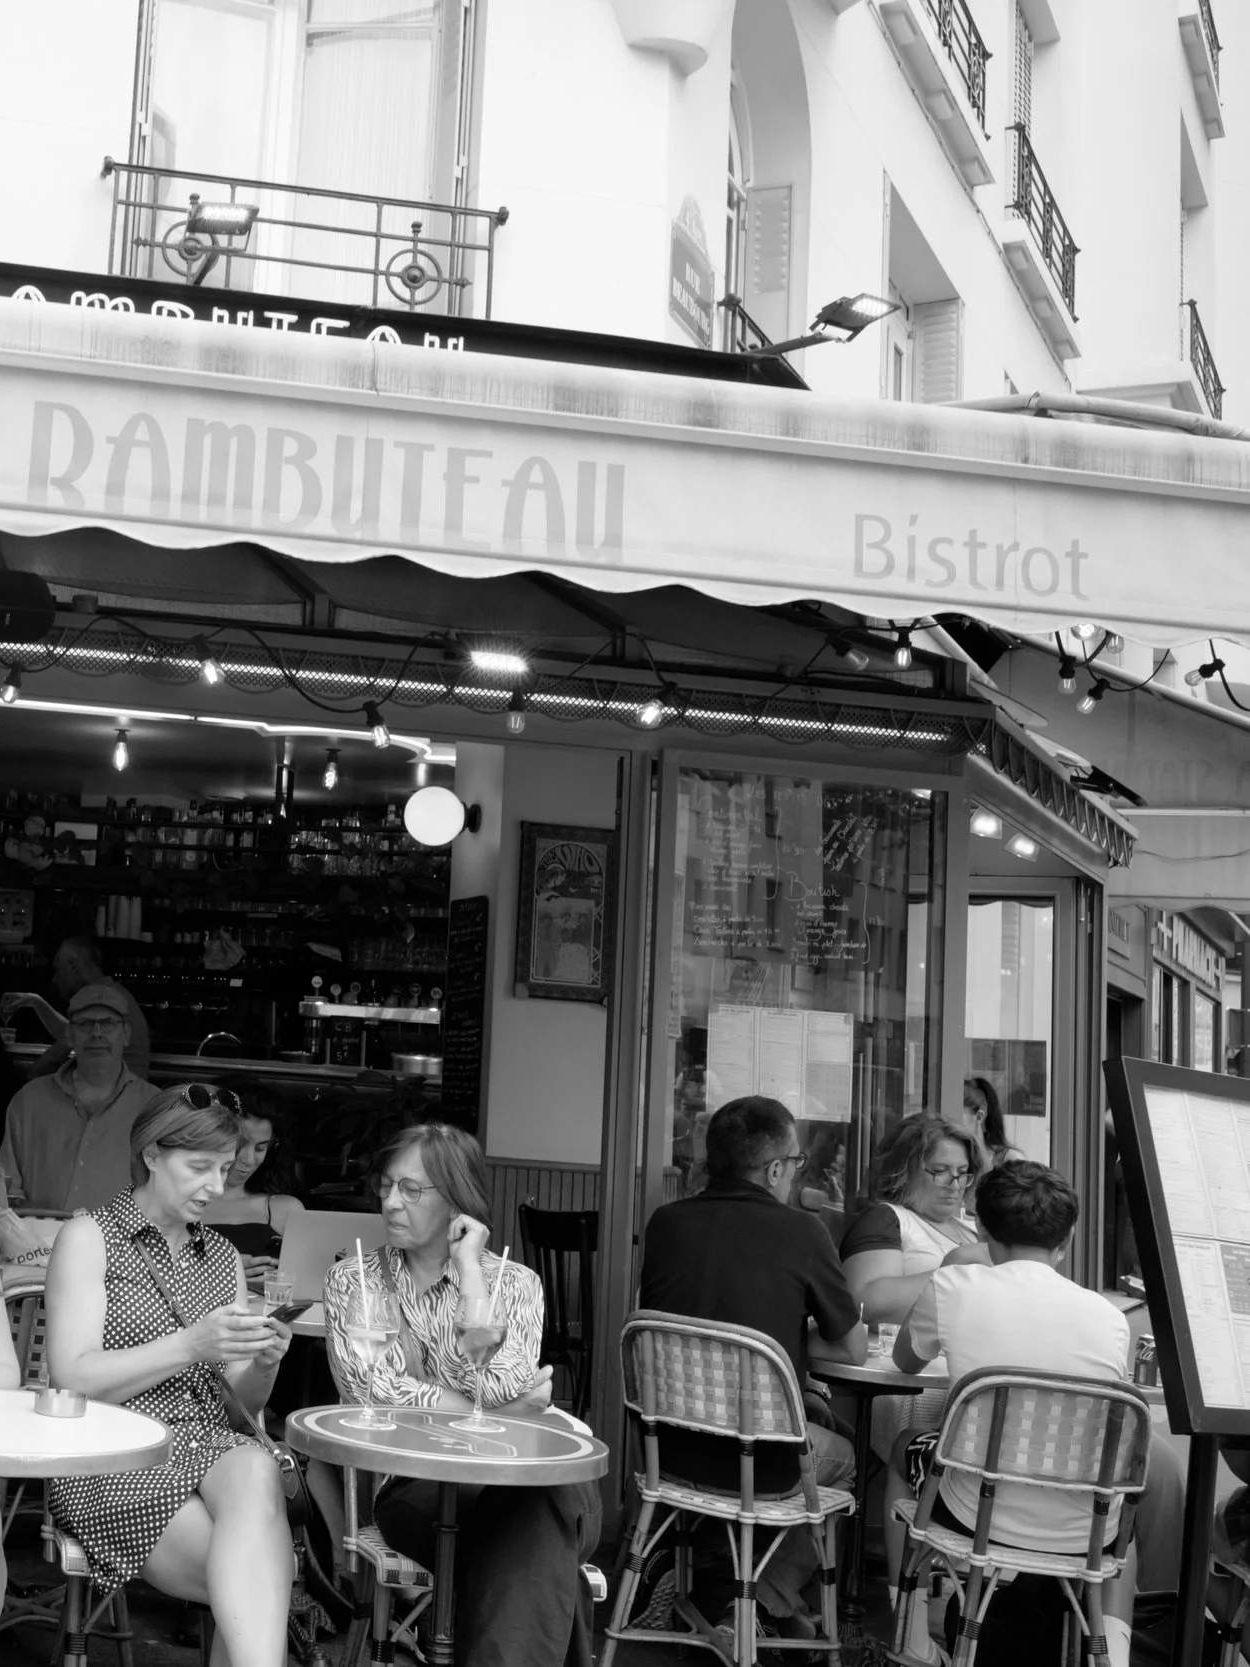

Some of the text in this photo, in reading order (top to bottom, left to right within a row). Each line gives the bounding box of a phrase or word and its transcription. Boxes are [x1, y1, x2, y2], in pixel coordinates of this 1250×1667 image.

[685, 261, 701, 295] RUE
[672, 276, 710, 335] BEAUBOURG
[853, 514, 1089, 600] Bistrot
[555, 843, 601, 872] WHO
[784, 871, 840, 902] British
